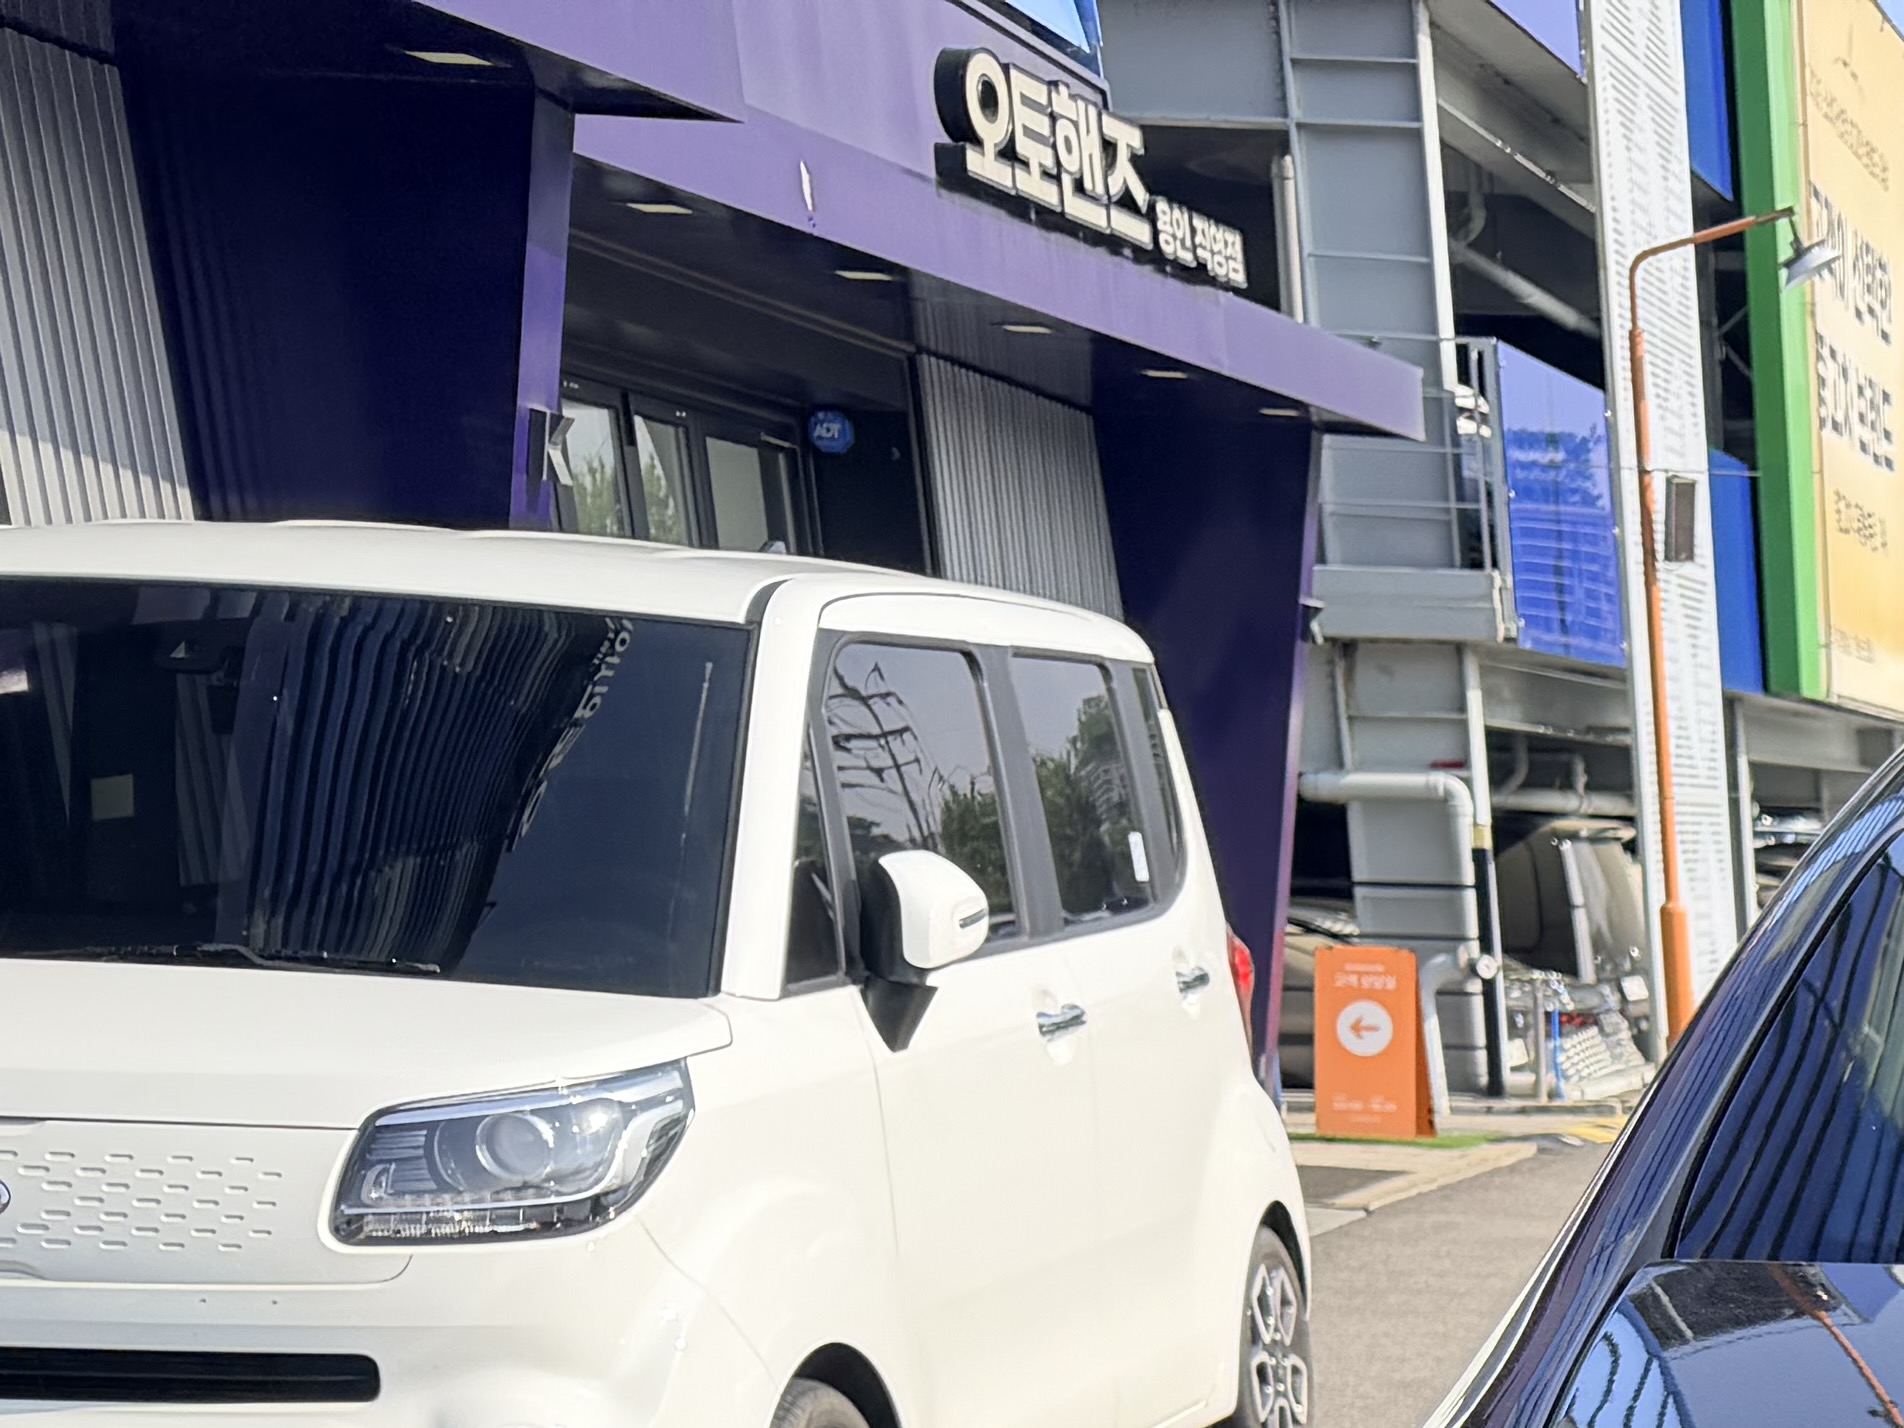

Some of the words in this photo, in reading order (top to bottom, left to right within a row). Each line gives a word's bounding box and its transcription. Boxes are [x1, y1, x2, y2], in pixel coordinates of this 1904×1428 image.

[962, 50, 1153, 249] 오토핸즈
[1156, 197, 1197, 268] 용인
[1192, 211, 1248, 288] 직영점
[813, 422, 842, 440] ADT
